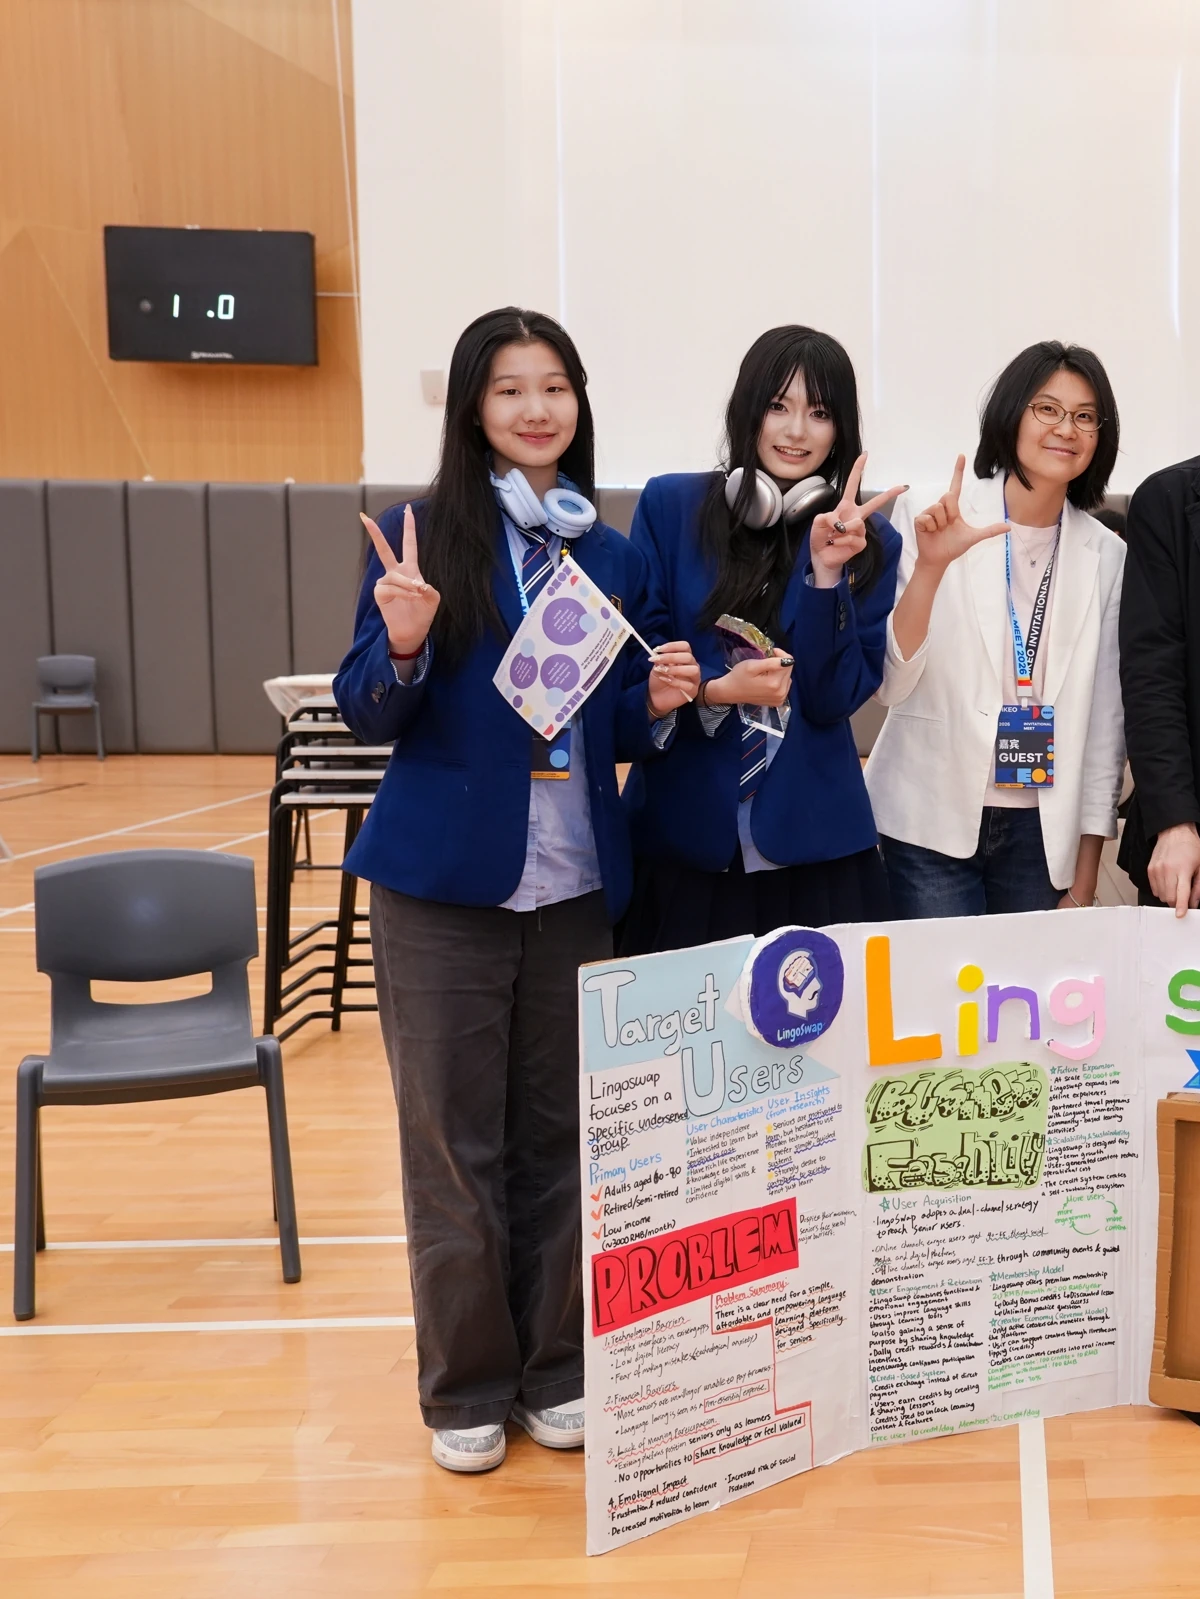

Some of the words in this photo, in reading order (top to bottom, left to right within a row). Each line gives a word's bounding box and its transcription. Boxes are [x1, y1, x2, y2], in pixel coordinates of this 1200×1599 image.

[1029, 578, 1050, 647] INVITATIONAL
[1013, 620, 1023, 649] MEET
[1017, 650, 1027, 675] 2026
[999, 739, 1019, 749] 嘉宾
[999, 753, 1043, 762] GUEST
[583, 970, 720, 1055] Target
[865, 935, 1107, 1066] Ling
[682, 1041, 804, 1117] Users
[1056, 1066, 1078, 1074] Future
[589, 1100, 638, 1120] focuses
[644, 1095, 659, 1107] on
[664, 1092, 672, 1100] a
[768, 1097, 789, 1109] User
[795, 1085, 830, 1102] Insights
[686, 1123, 708, 1136] User
[590, 1137, 628, 1160] group
[590, 1162, 626, 1185] Primary
[629, 1153, 662, 1171] Users
[604, 1183, 631, 1198] Adults
[633, 1175, 652, 1190] aged
[1087, 1193, 1105, 1202] users
[892, 1198, 918, 1210] User
[923, 1194, 972, 1207] Acquisition
[603, 1223, 618, 1237] Low
[623, 1215, 651, 1231] income
[593, 1209, 797, 1328] PROBLEM
[997, 1268, 1040, 1281] Membership
[1042, 1264, 1064, 1275] Model
[869, 1338, 897, 1348] purpose
[898, 1336, 907, 1347] by
[619, 1474, 631, 1483] No
[683, 1453, 692, 1463] to
[695, 1447, 716, 1459] share
[617, 1484, 659, 1506] Emotional
[662, 1475, 687, 1490] Impact
[611, 1517, 647, 1536] Decreased
[684, 1504, 691, 1513] to
